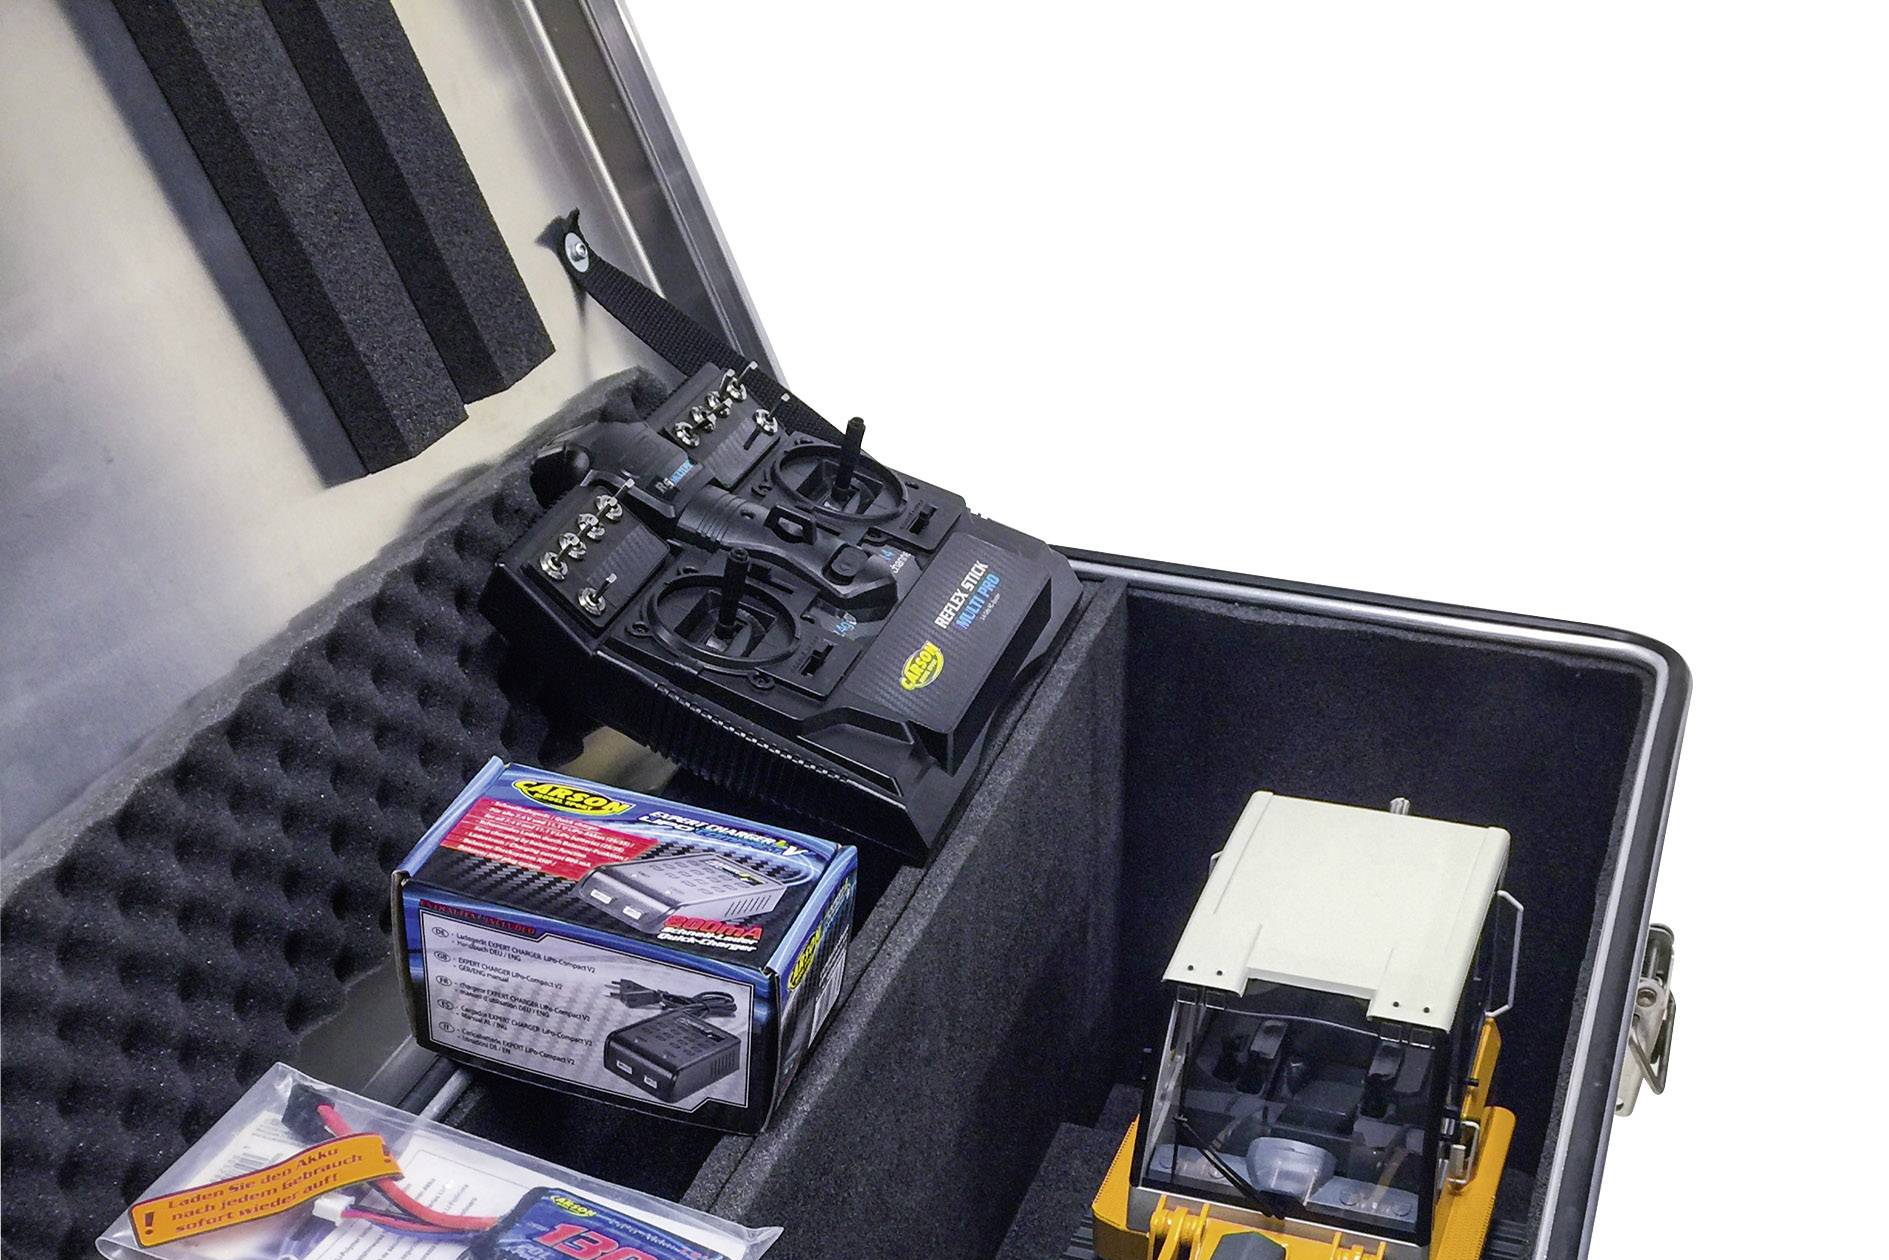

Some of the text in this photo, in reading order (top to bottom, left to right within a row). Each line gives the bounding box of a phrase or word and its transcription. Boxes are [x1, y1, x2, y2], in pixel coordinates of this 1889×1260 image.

[934, 560, 989, 629] REFLEX STICK
[956, 595, 985, 630] MULTI
[977, 574, 1000, 597] PRO
[899, 641, 941, 690] CARSON
[515, 780, 631, 815] CARSON
[649, 811, 776, 845] EXPERT CHARGER
[458, 957, 480, 968] EXPERT
[481, 963, 510, 976] CHARGER
[487, 940, 510, 951] EXPERT
[511, 946, 542, 959] CHARGER
[486, 989, 508, 1000] EXPERT
[509, 995, 539, 1008] CHARGER
[488, 1012, 510, 1024] EXPERT
[511, 1018, 539, 1032] CHARGER
[169, 1148, 340, 1209] Laden Sie den Akku
[172, 1154, 363, 1221] nach jedem Gebrauch
[175, 1211, 234, 1233] sofort
[240, 1192, 297, 1217] wieder
[551, 1196, 597, 1217] CARSON
